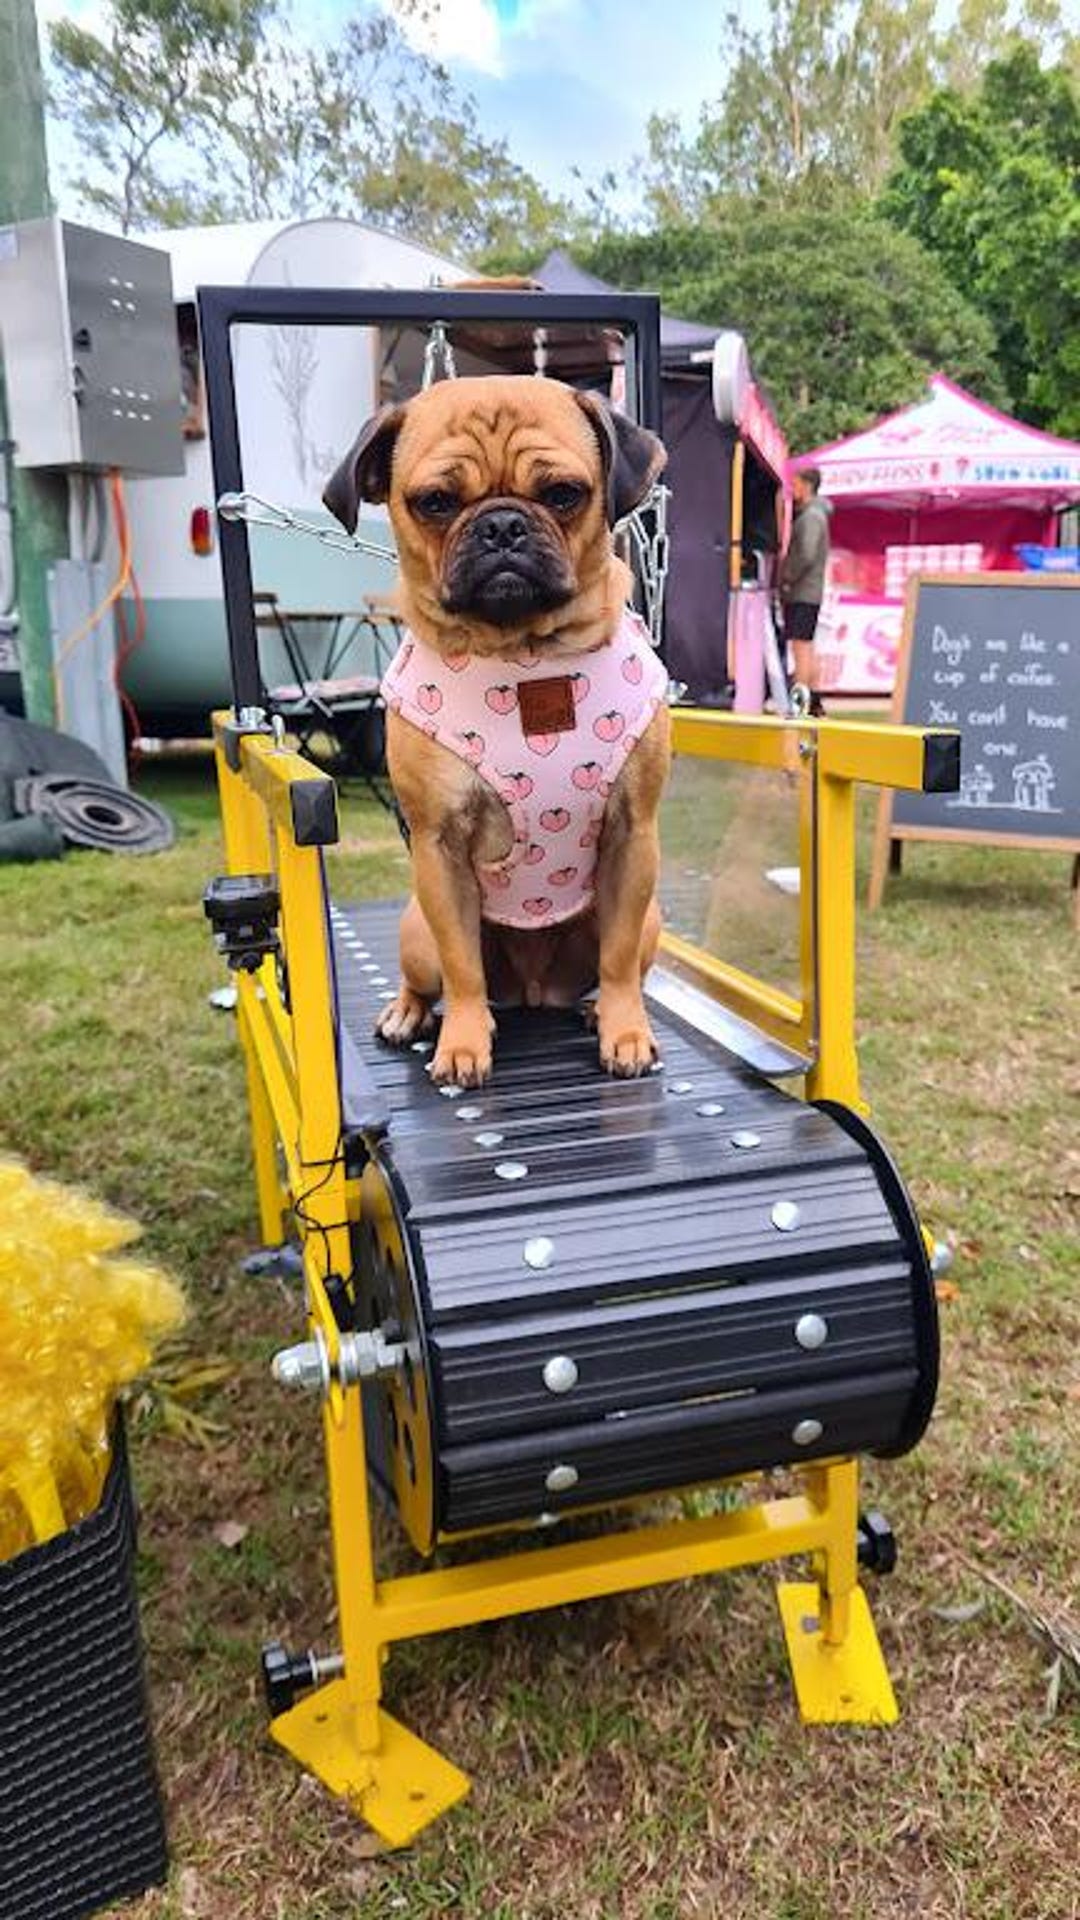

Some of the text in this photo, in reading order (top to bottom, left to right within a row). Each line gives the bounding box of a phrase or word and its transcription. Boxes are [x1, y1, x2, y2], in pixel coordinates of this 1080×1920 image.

[1020, 631, 1046, 653] like
[1056, 641, 1070, 653] a
[933, 670, 965, 688] cup
[979, 662, 1000, 683] of
[928, 700, 958, 724] You
[1026, 708, 1068, 731] have
